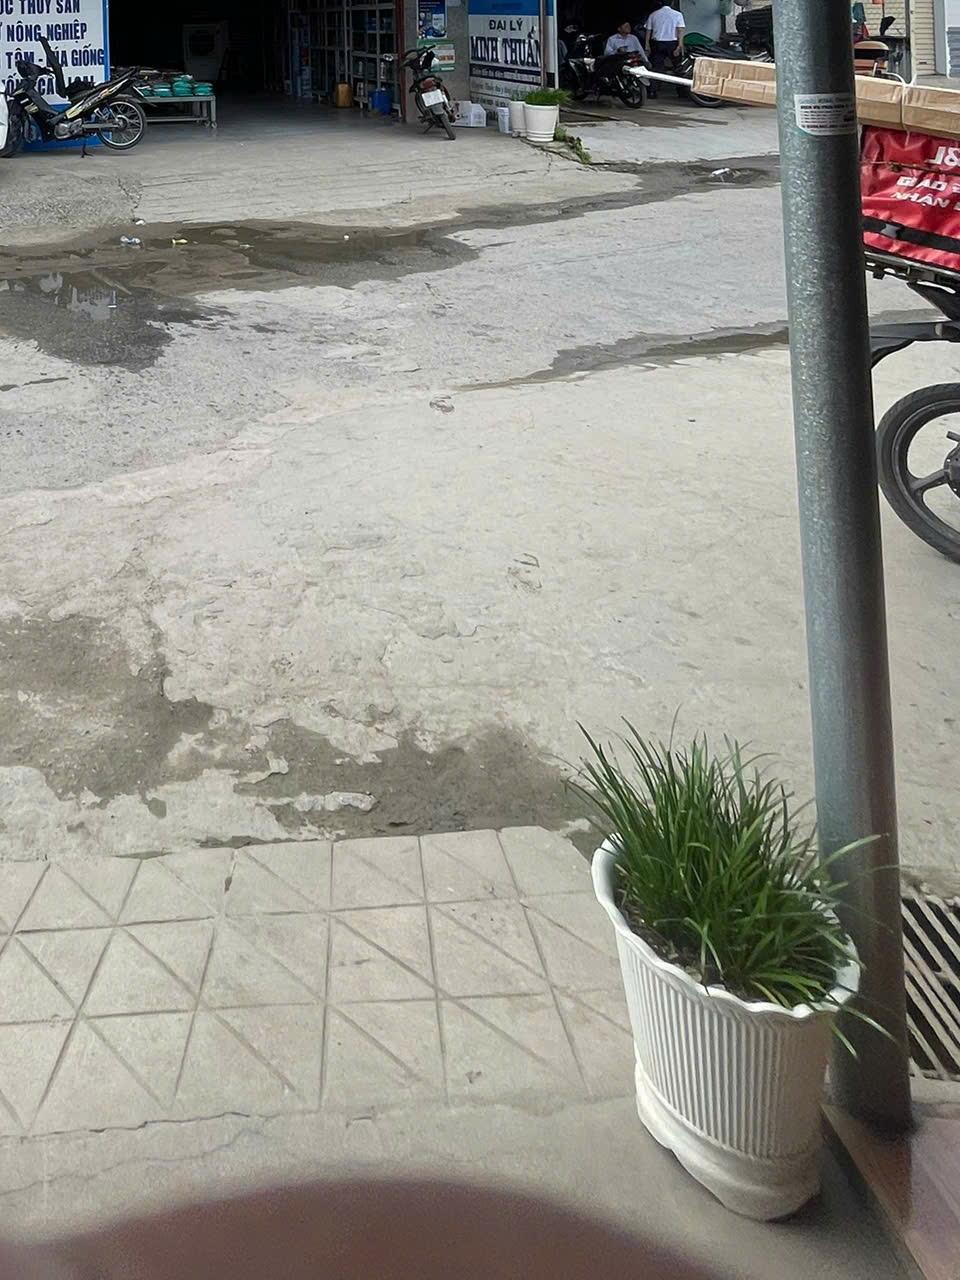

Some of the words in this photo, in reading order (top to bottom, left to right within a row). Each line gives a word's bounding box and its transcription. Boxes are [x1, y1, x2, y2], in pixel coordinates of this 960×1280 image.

[7, 20, 41, 42] NÔNG
[46, 19, 87, 43] NGHIỆP
[489, 20, 506, 32] ĐẠI
[510, 18, 523, 31] LÝ
[71, 43, 105, 66] GIỐNG
[471, 36, 500, 62] MINH
